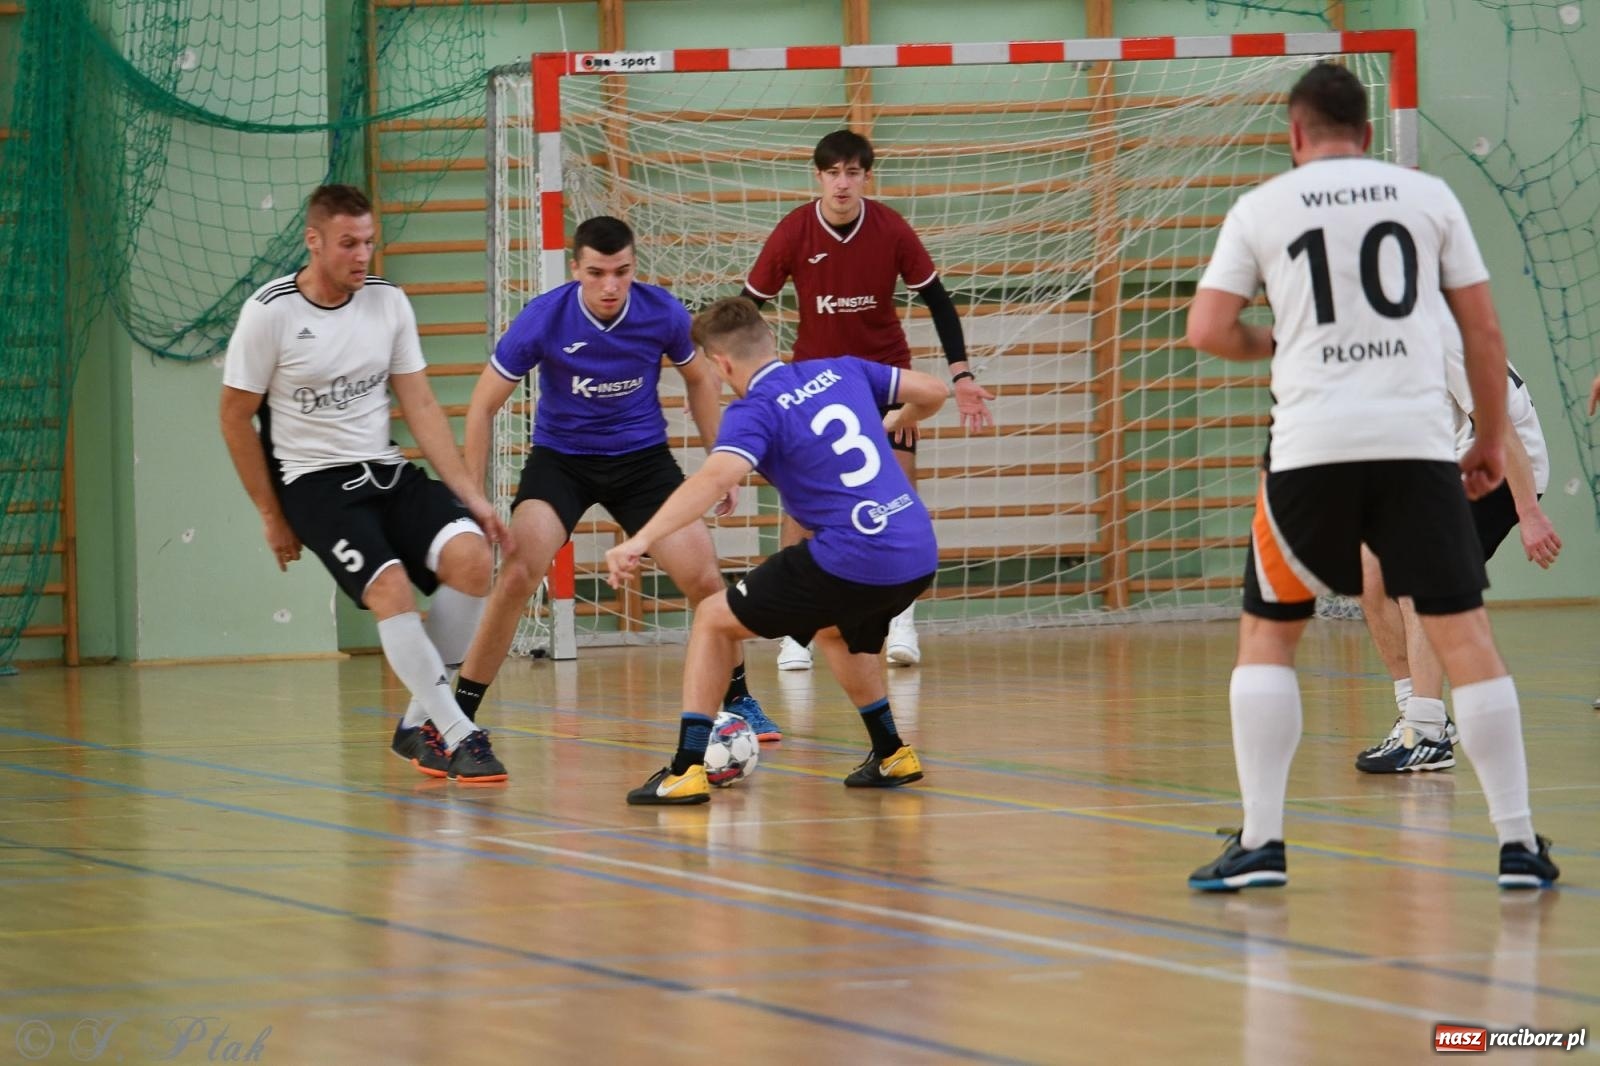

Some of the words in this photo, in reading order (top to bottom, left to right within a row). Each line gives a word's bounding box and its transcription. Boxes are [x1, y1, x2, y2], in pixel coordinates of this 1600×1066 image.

[621, 56, 656, 68] sport
[1302, 185, 1398, 207] WICHER
[1287, 220, 1418, 326] 10
[816, 295, 878, 314] K-INSTAL
[1322, 340, 1408, 364] PŁONIA
[810, 403, 881, 488] 3
[332, 538, 364, 573] 5
